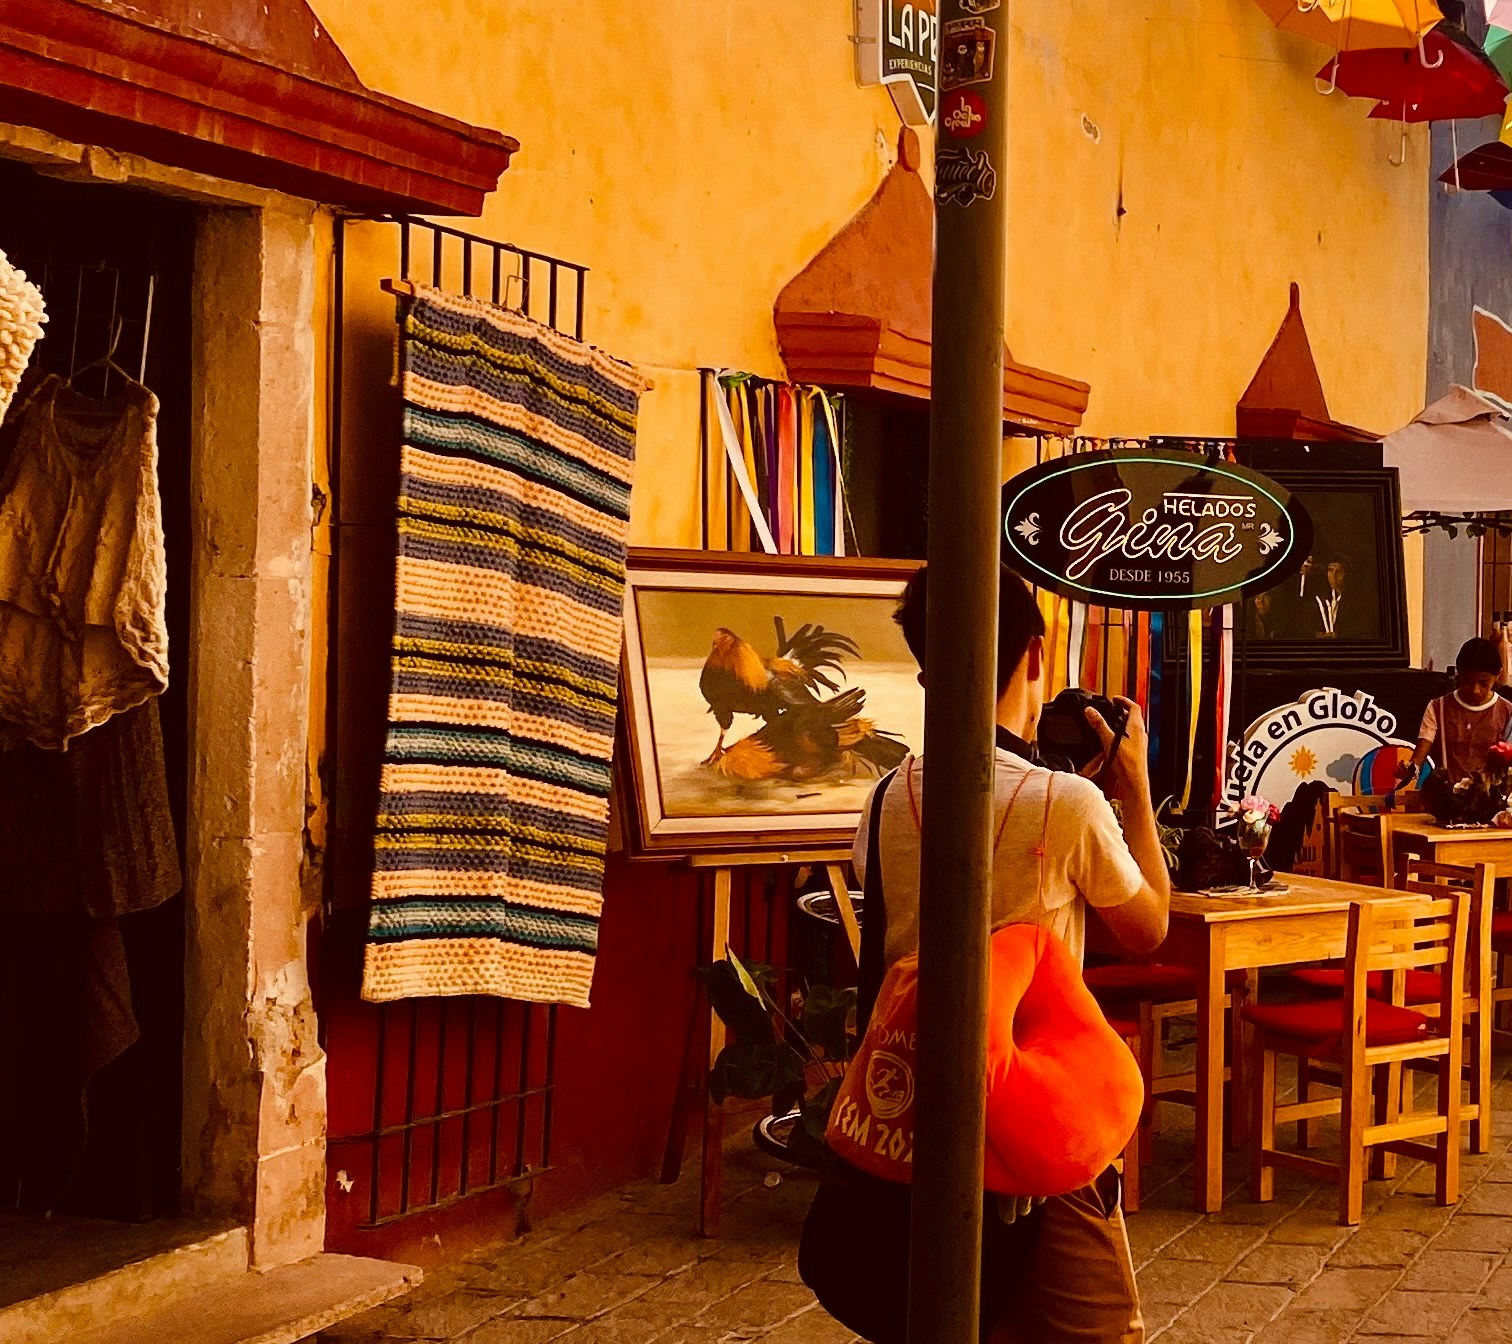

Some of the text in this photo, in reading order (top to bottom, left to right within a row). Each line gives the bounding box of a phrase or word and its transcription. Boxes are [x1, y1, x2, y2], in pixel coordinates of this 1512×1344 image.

[918, 9, 937, 62] PE
[888, 58, 932, 76] EXPERIENCIAS
[1163, 498, 1257, 519] HELADOS
[1059, 488, 1243, 581] Gina
[1109, 568, 1190, 584] DESDE 1955
[1267, 709, 1303, 740] en
[1308, 692, 1395, 734] Globo
